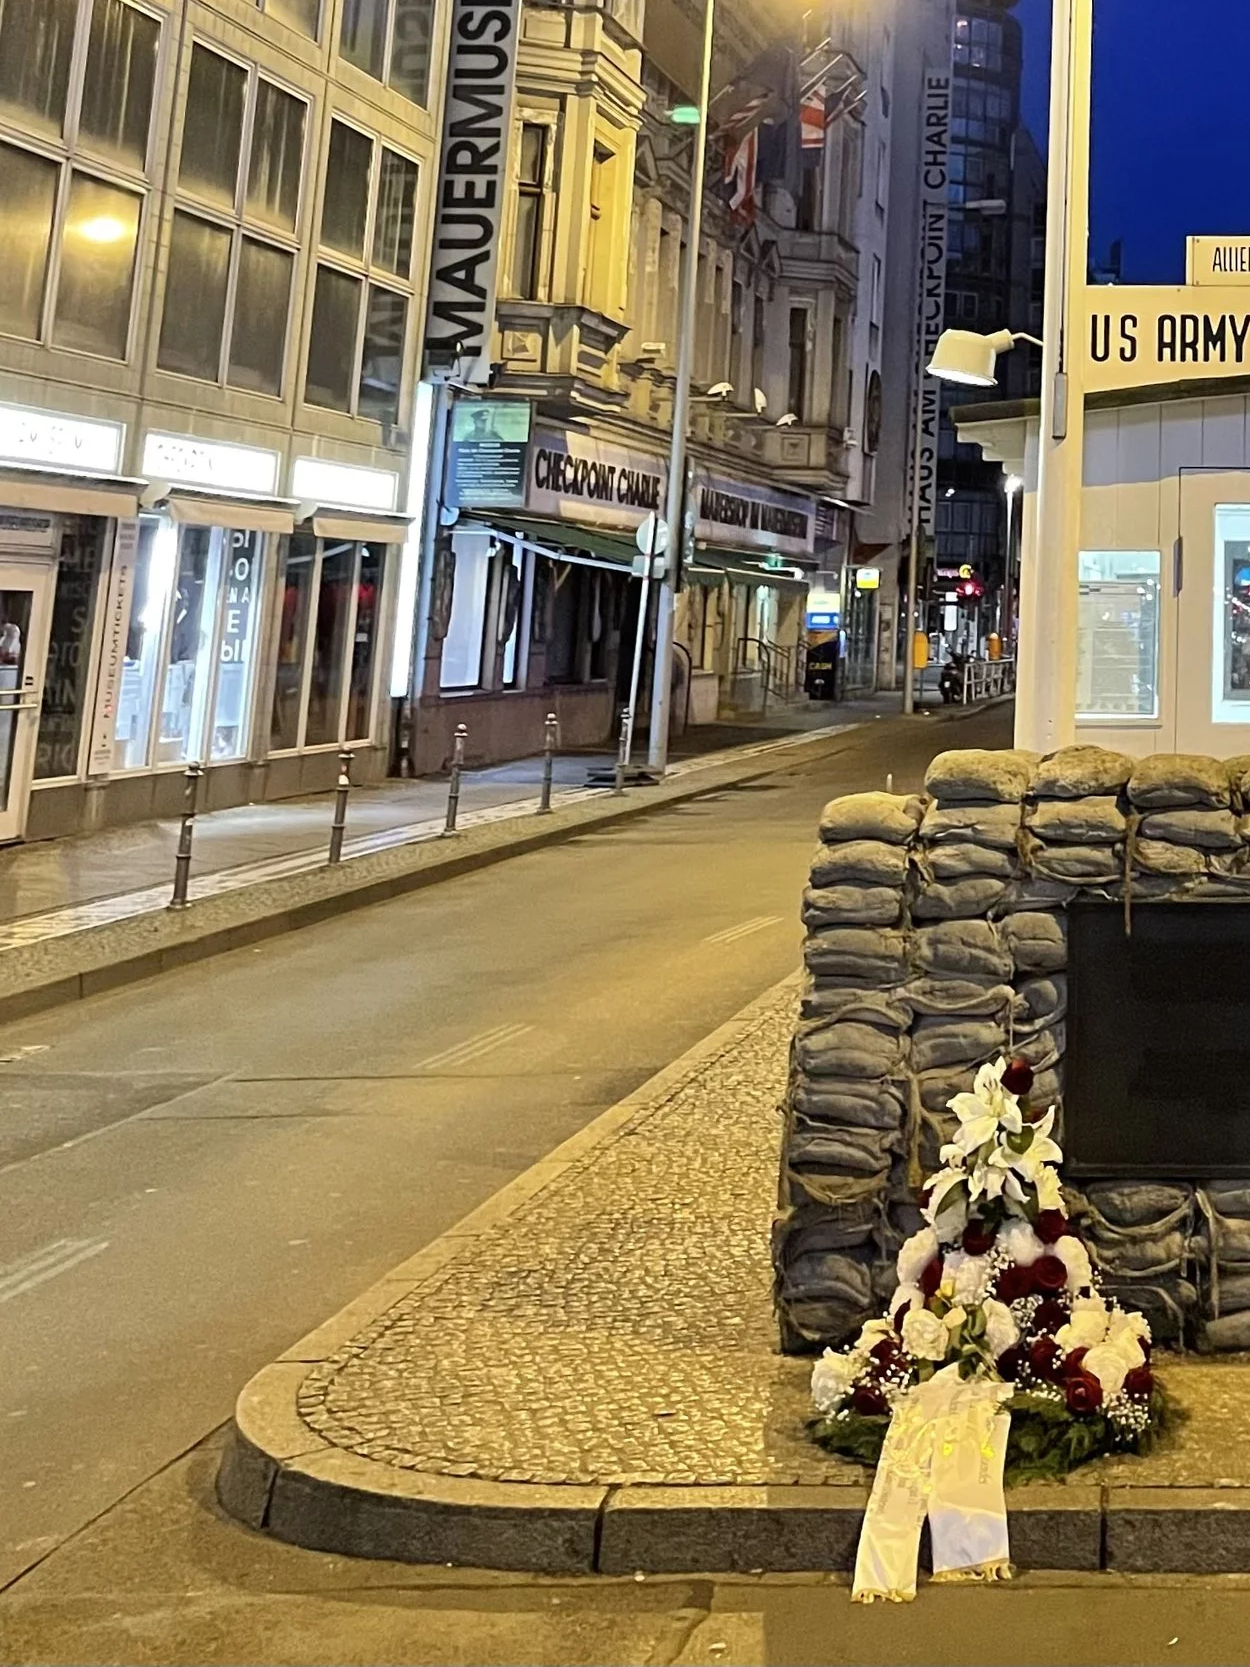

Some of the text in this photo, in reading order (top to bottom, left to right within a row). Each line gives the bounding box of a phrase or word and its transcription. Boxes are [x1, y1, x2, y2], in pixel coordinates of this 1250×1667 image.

[923, 76, 950, 190] CHARLIE
[911, 389, 937, 437] AM
[535, 448, 617, 501] CHECKPOINT
[617, 467, 661, 511] CHARLIE
[909, 447, 935, 525] HAUS
